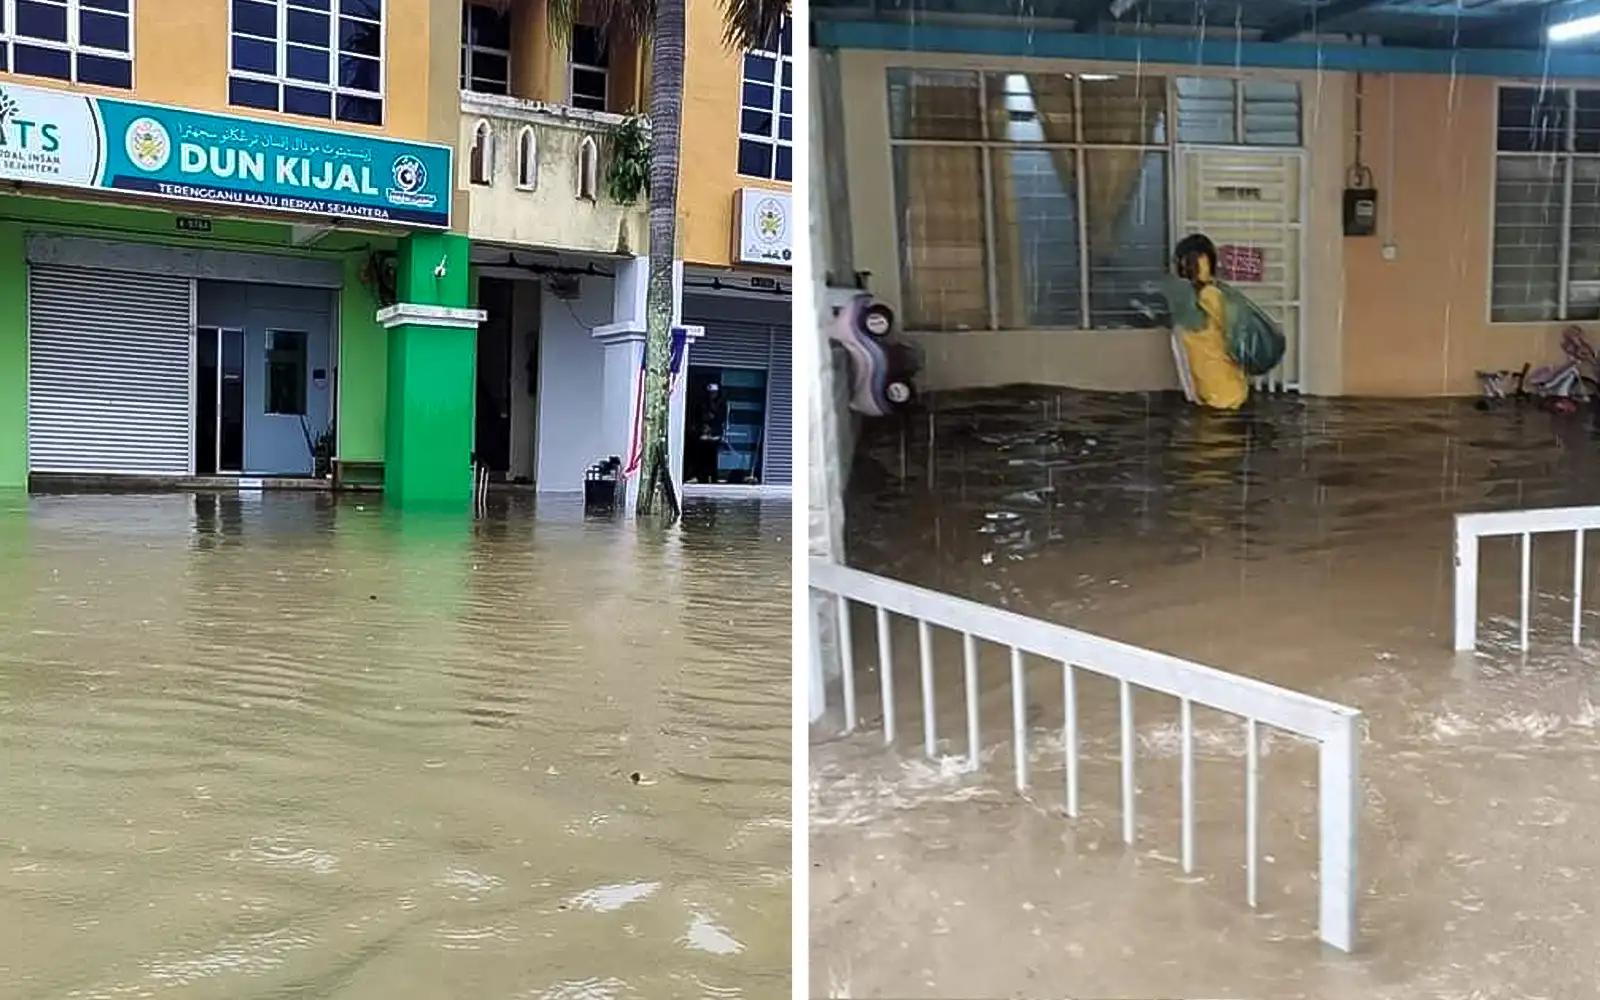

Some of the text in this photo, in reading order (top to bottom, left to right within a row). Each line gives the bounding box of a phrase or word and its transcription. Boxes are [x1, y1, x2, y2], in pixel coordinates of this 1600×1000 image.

[180, 142, 379, 195] DUN KIJAL
[159, 183, 389, 218] TERENGGANU MAJU BERKAT SEJAHTERA
